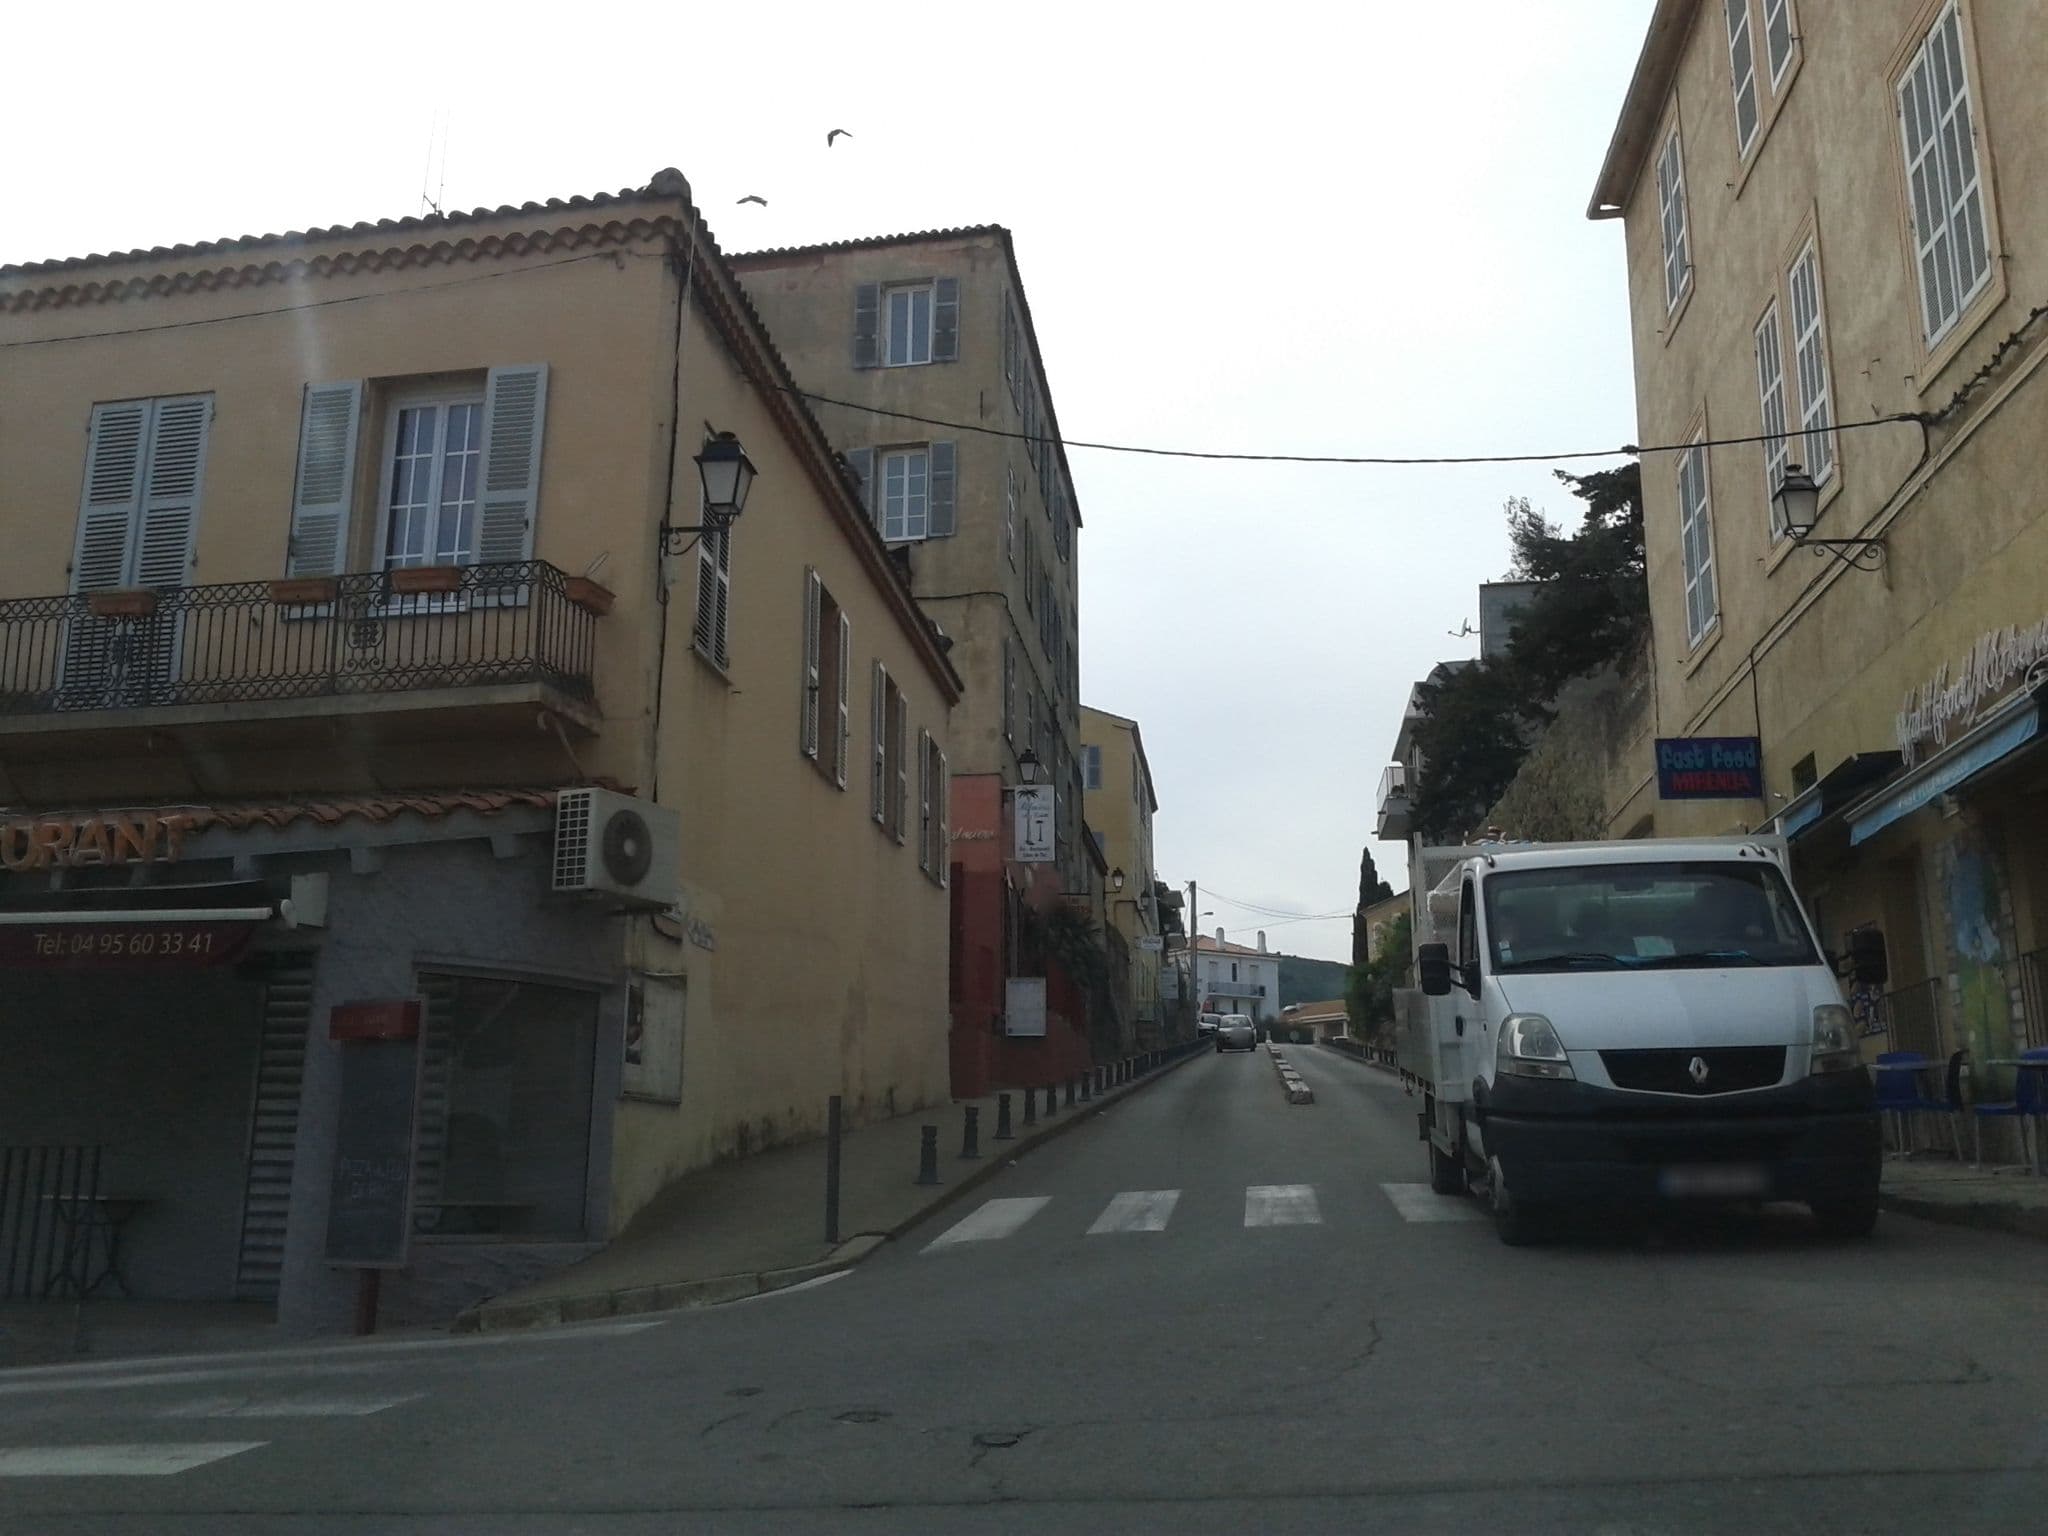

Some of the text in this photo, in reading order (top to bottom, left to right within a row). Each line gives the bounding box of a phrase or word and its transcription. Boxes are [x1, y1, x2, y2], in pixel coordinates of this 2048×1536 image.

[34, 932, 213, 955] Tel: 04 95 60 33 41
